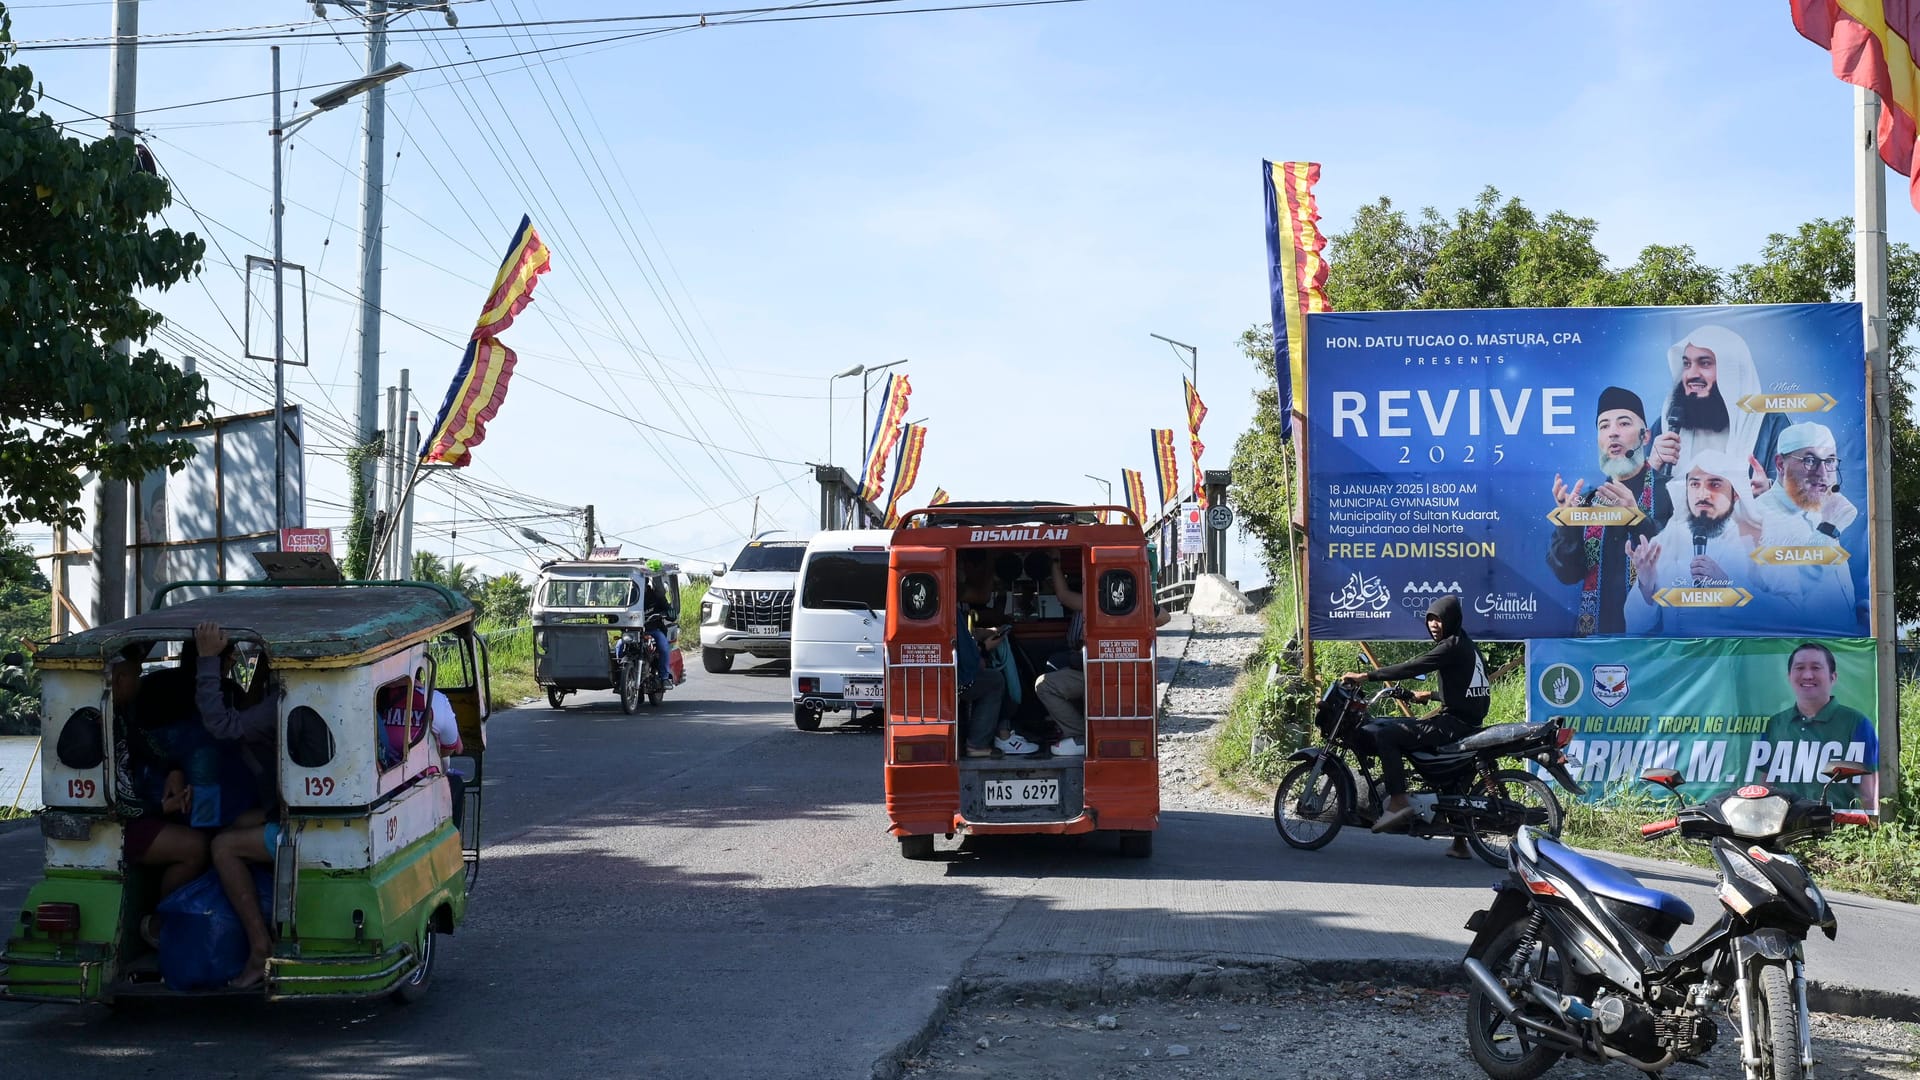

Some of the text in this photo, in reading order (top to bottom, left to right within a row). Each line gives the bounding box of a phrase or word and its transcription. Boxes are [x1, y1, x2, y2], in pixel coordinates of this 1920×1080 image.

[1326, 332, 1582, 349] HON. DATU TUCAO O. MASTURA, CPA
[1405, 355, 1504, 366] PRESENTS
[1765, 397, 1808, 409] MENK
[1332, 387, 1576, 438] REVIVE
[1398, 444, 1504, 465] 2025
[1329, 484, 1340, 495] 18
[1342, 483, 1394, 495] JANUARY
[1396, 483, 1424, 494] 2025
[1432, 483, 1457, 494] 8:00
[1458, 483, 1477, 494] AM
[1329, 496, 1460, 508] MUNICIPAL GYMNASIUM
[1329, 509, 1500, 524] Municipality of Sultan Kudarat,
[1570, 511, 1622, 521] IBRAHIM
[969, 528, 1069, 543] BISMILLAH
[1329, 523, 1464, 537] Maguindanao del Norte
[287, 535, 328, 546] ASENSO
[1328, 541, 1496, 559] FREE ADMISSION
[1775, 549, 1824, 561] SALAH
[1681, 591, 1724, 603] MENK
[1329, 610, 1355, 619] LIGHT
[1365, 610, 1392, 619] LIGHT
[1493, 612, 1534, 620] INITIATIVE
[844, 687, 884, 697] MAW 3201
[1584, 716, 1603, 734] NG
[1606, 716, 1653, 735] LAHAT,
[1657, 717, 1700, 733] TROPA
[1703, 717, 1724, 734] NG
[1726, 717, 1771, 733] LAHAT
[1538, 740, 1680, 782] ARWIN
[1686, 741, 1737, 783] M.
[67, 777, 97, 800] 139
[304, 776, 336, 797] 139
[988, 785, 1057, 801] MAS 6297
[384, 814, 399, 843] 139
